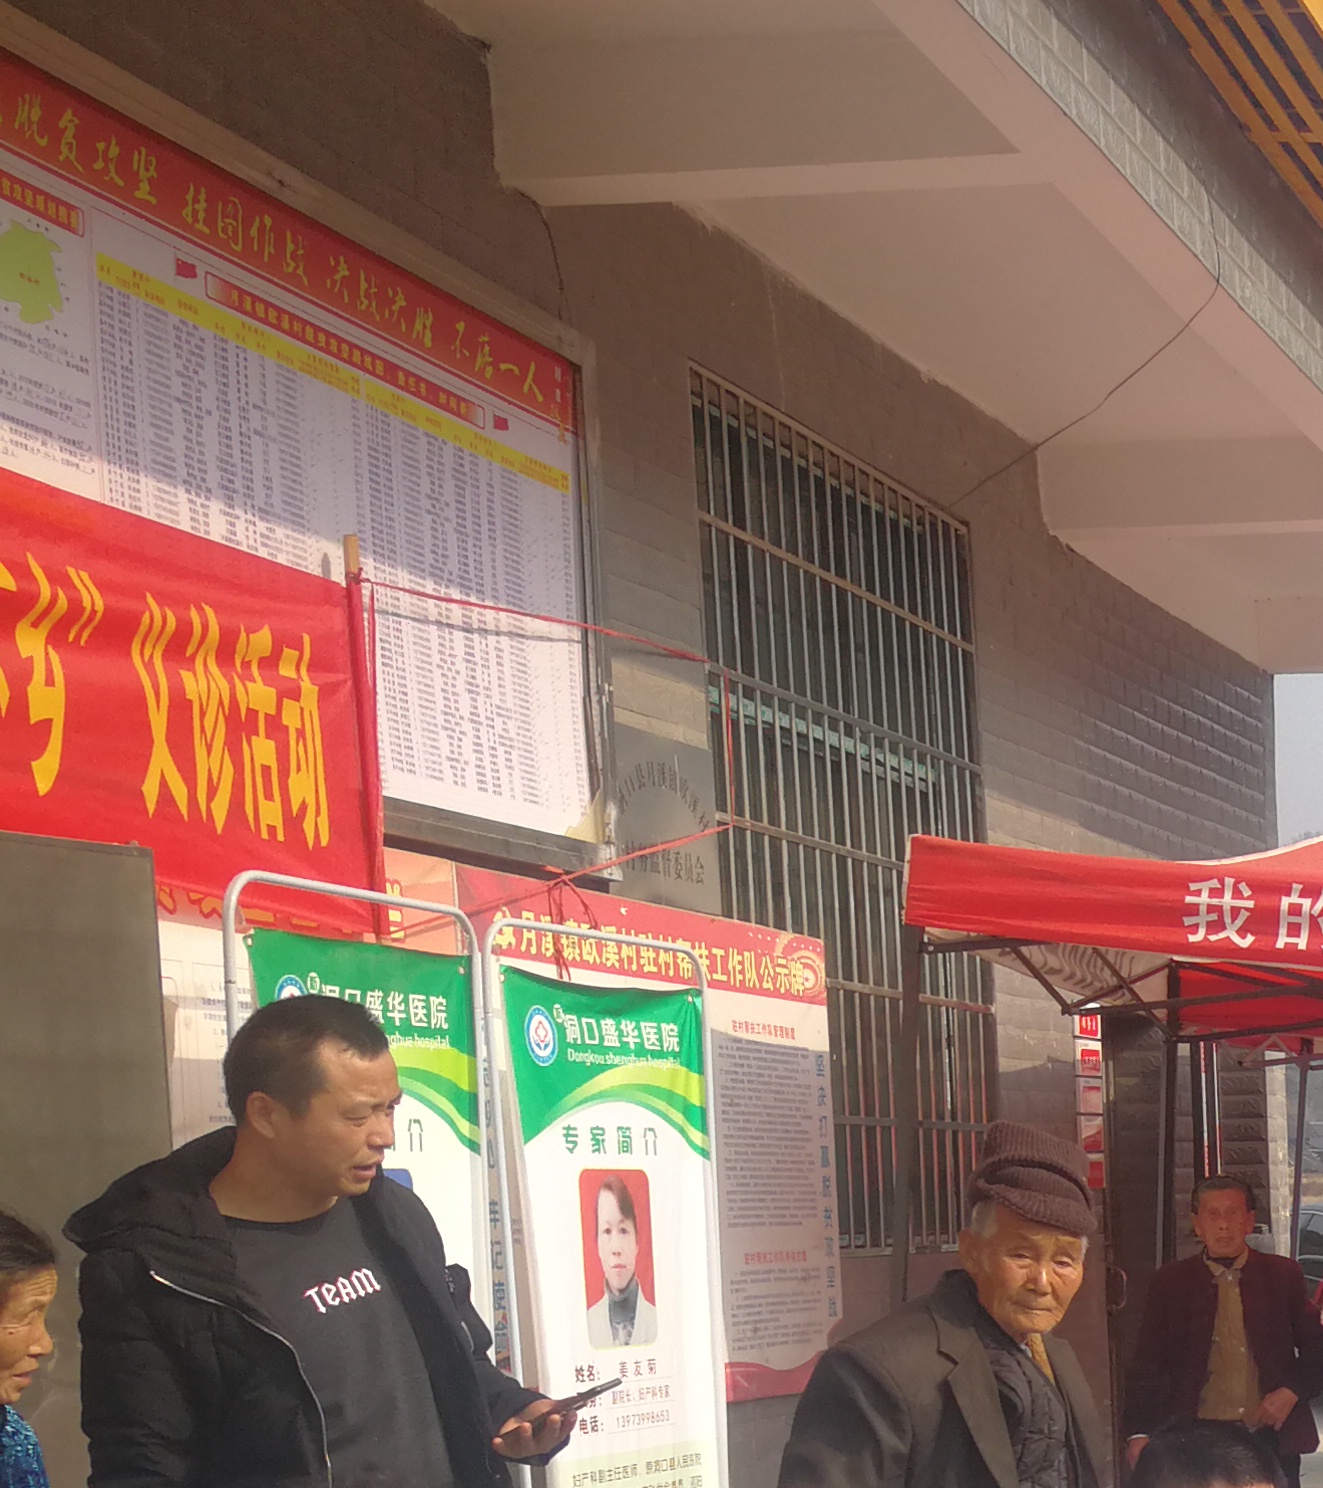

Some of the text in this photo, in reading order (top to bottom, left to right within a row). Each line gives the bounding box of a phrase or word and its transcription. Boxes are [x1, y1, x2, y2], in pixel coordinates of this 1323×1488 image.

[563, 1013, 681, 1053] 洞口盛华医院
[562, 1123, 658, 1157] 专家简介
